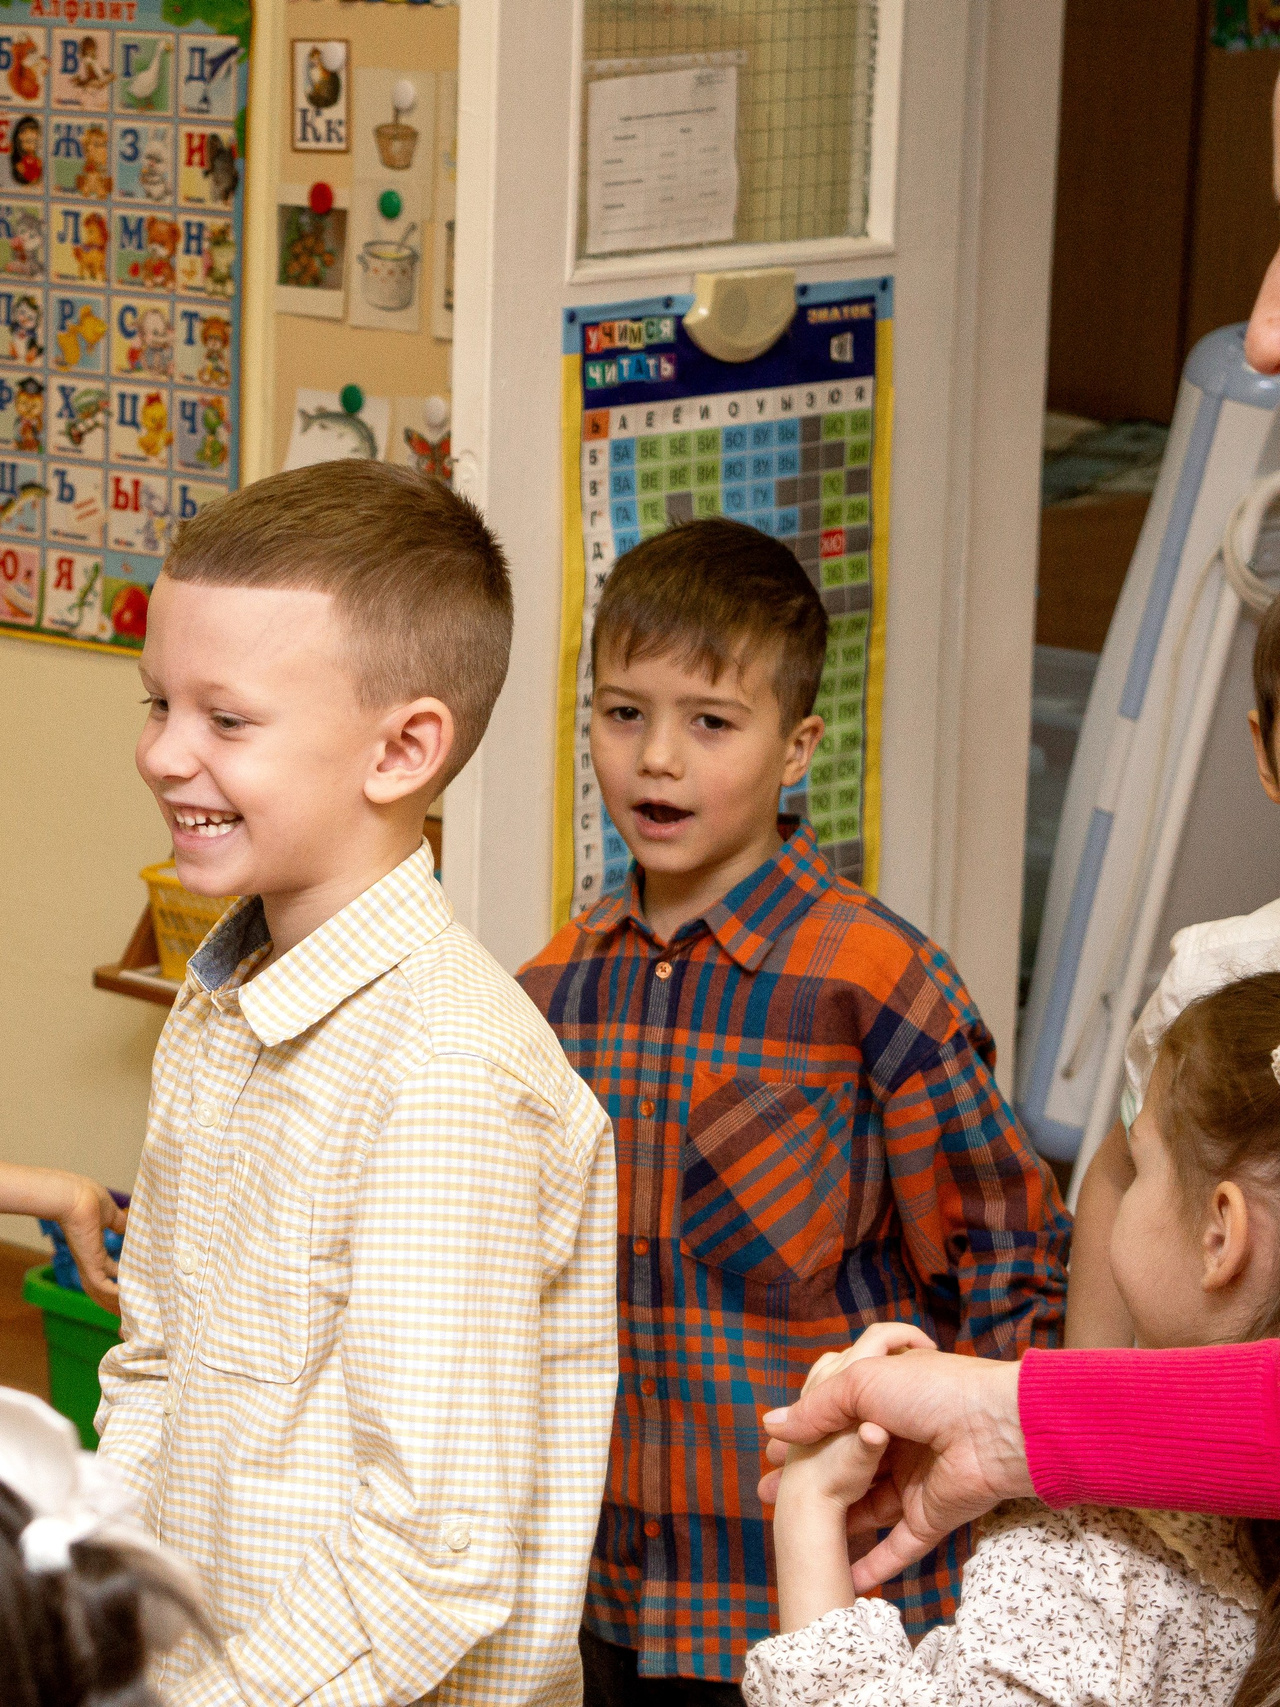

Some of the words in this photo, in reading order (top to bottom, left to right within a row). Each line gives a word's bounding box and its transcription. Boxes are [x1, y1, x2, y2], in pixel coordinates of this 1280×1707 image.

[61, 39, 79, 74] В
[123, 44, 140, 77] Г
[185, 47, 207, 84] Д
[52, 123, 84, 158] Ж
[121, 129, 139, 162] З
[299, 107, 344, 142] Кк
[57, 211, 80, 244] Л
[121, 216, 144, 250] М
[184, 221, 204, 256] Н
[59, 299, 75, 331] Р
[119, 305, 139, 339] С
[181, 311, 200, 345] Т
[587, 320, 673, 350] УЧИМСЯ
[588, 356, 675, 386] ЧИТАТЬ
[57, 386, 76, 419] Х
[118, 393, 141, 430] Ц
[180, 400, 198, 434] Ч
[619, 414, 627, 430] А
[699, 405, 710, 420] И
[728, 401, 739, 417] О
[756, 399, 765, 414] У
[828, 388, 841, 404] Ю
[54, 470, 76, 503] Ъ
[111, 477, 141, 513] Ы
[180, 486, 198, 519] Ь
[54, 558, 74, 590] Я
